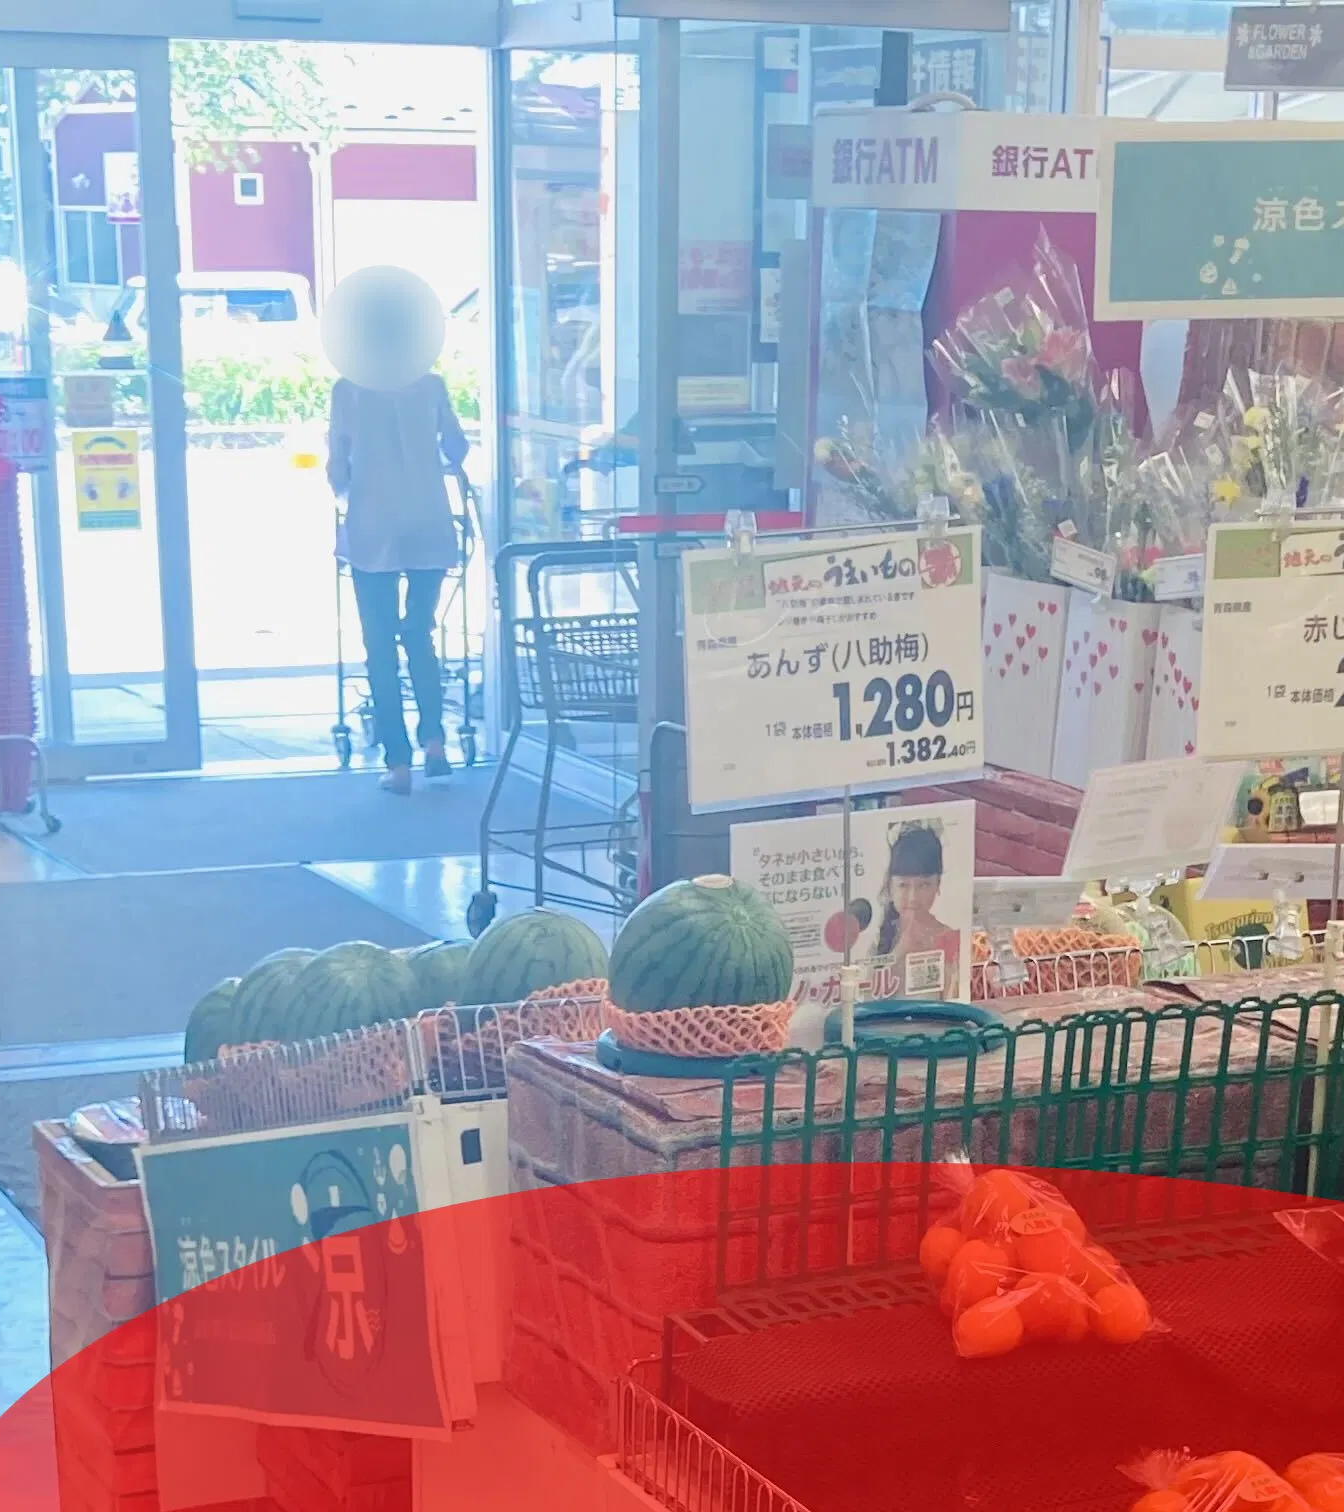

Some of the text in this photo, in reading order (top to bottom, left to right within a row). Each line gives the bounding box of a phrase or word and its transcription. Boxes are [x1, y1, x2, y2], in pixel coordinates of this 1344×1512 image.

[1252, 23, 1306, 42] FLOWER
[832, 135, 940, 185] 銀行ATM
[991, 144, 1096, 181] 銀行AT
[758, 863, 865, 887] そのまま食べも
[176, 1234, 287, 1292] 涼色スタイル
